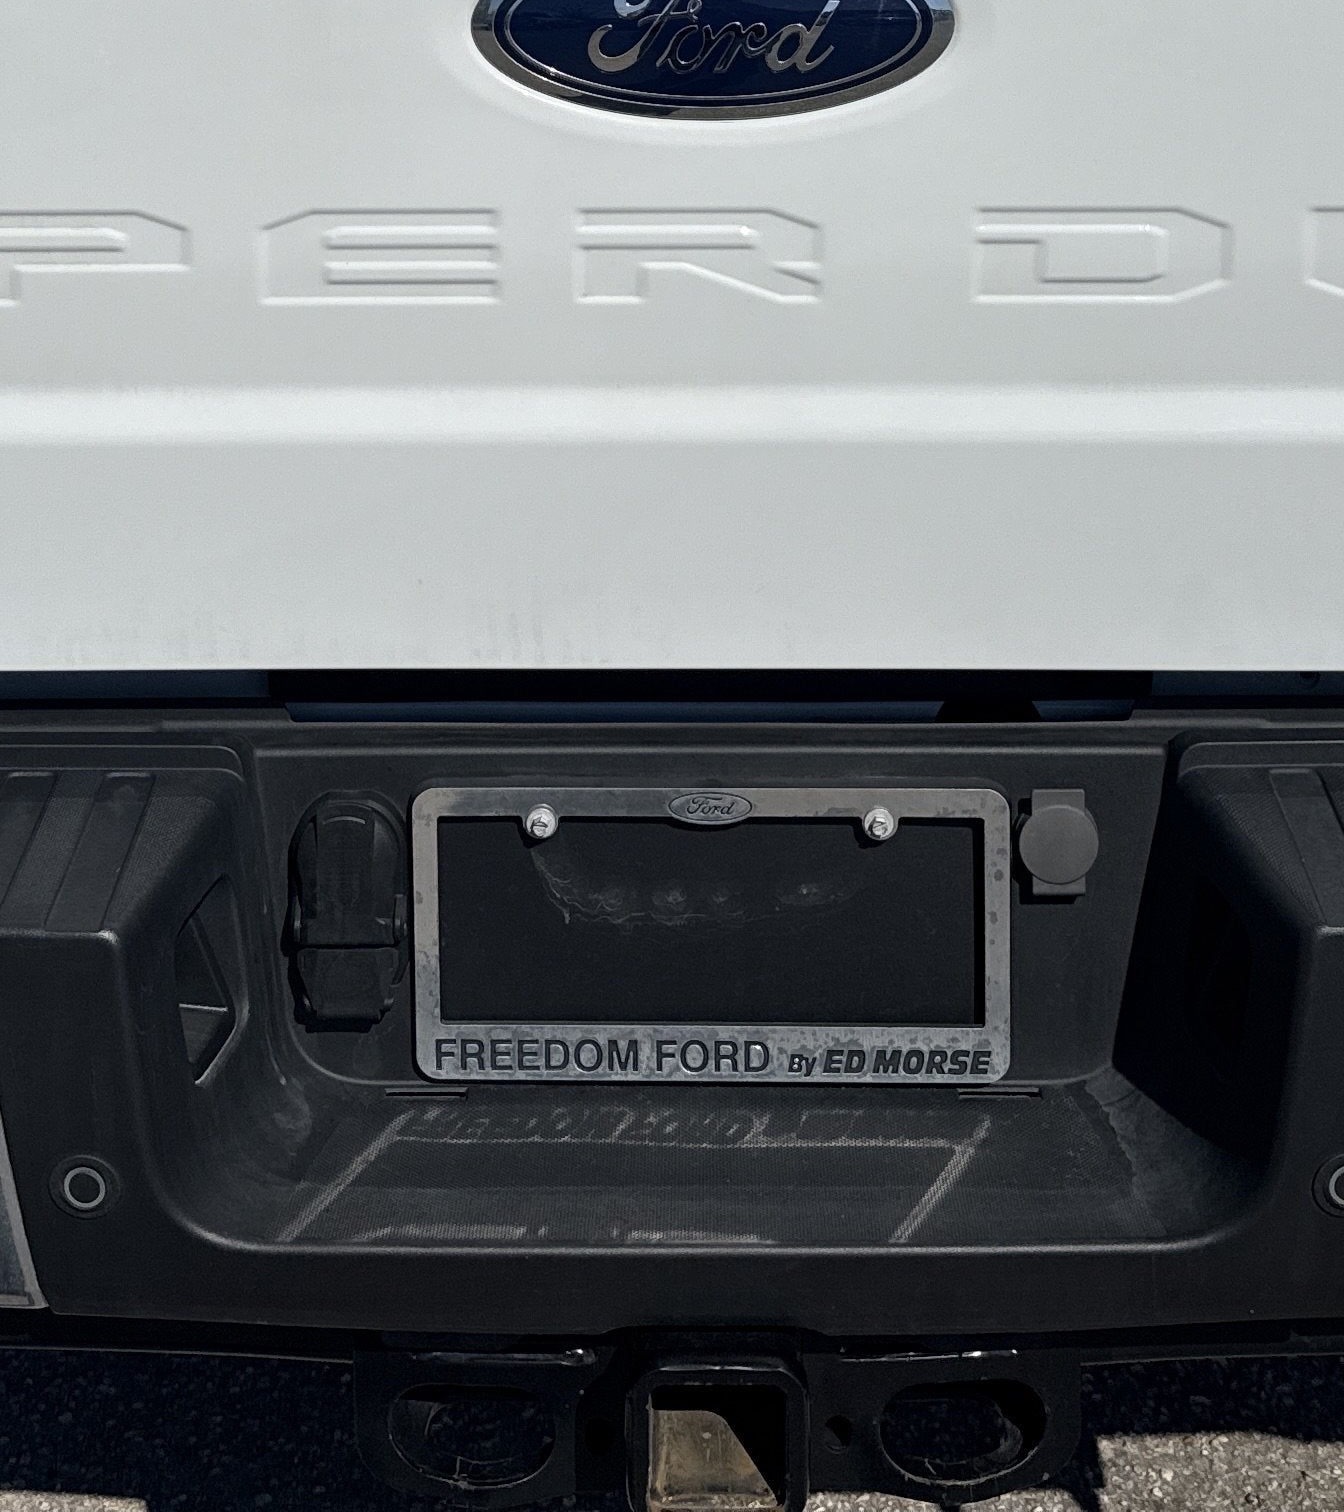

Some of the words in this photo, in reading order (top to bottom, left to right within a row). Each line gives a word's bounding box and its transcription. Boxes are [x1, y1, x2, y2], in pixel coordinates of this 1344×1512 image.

[686, 796, 735, 815] Ford
[435, 1039, 638, 1072] FREEDOM
[656, 1040, 769, 1073] FORD
[823, 1049, 865, 1074] ED
[872, 1049, 991, 1075] MORSE
